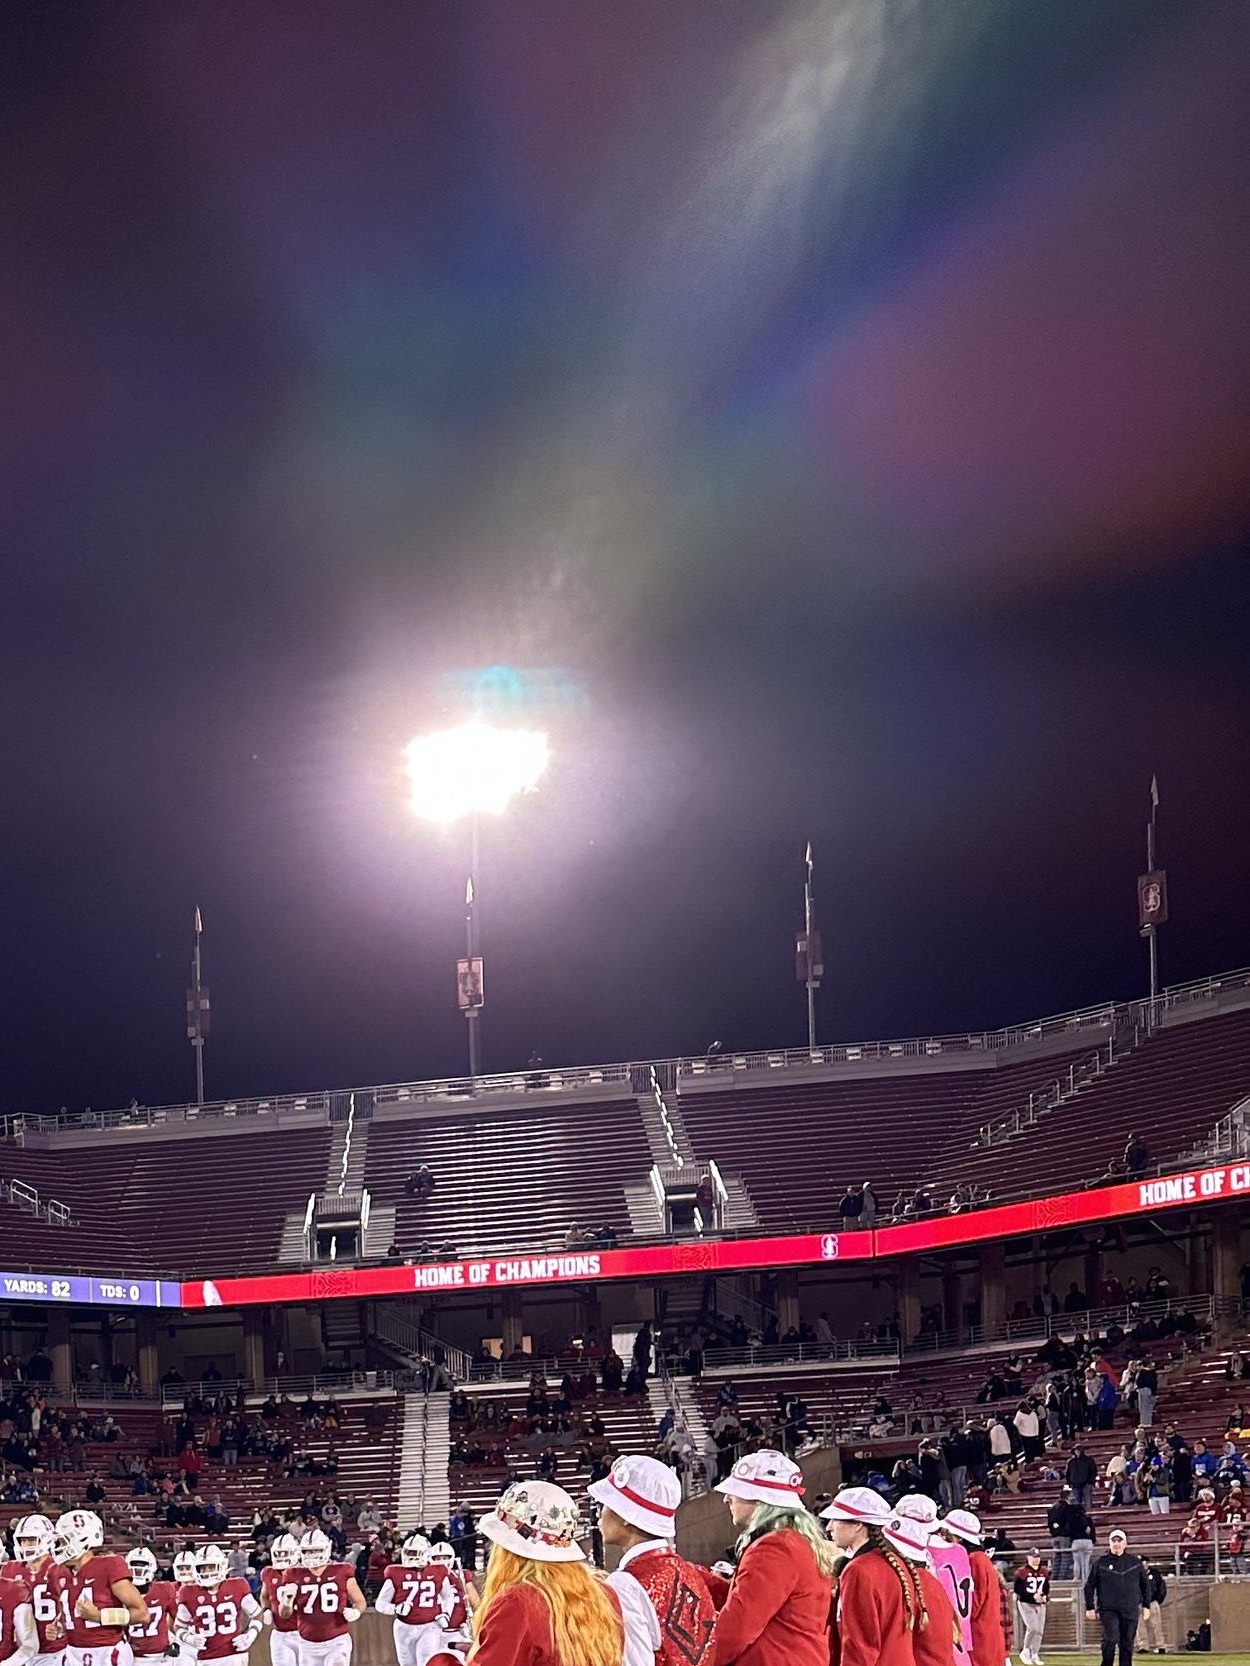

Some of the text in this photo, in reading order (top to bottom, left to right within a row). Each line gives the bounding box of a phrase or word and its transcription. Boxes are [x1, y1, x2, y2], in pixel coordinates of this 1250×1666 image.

[1138, 1176, 1196, 1206] HOME
[1201, 1169, 1226, 1195] OF
[414, 1255, 601, 1288] HOME OF CHAMPIONS
[3, 1278, 71, 1298] YARDS: 82
[100, 1284, 140, 1301] TDS: 0
[301, 1582, 339, 1614] 76
[402, 1581, 436, 1608] 72
[1026, 1576, 1046, 1594] 37
[196, 1601, 238, 1638] 33
